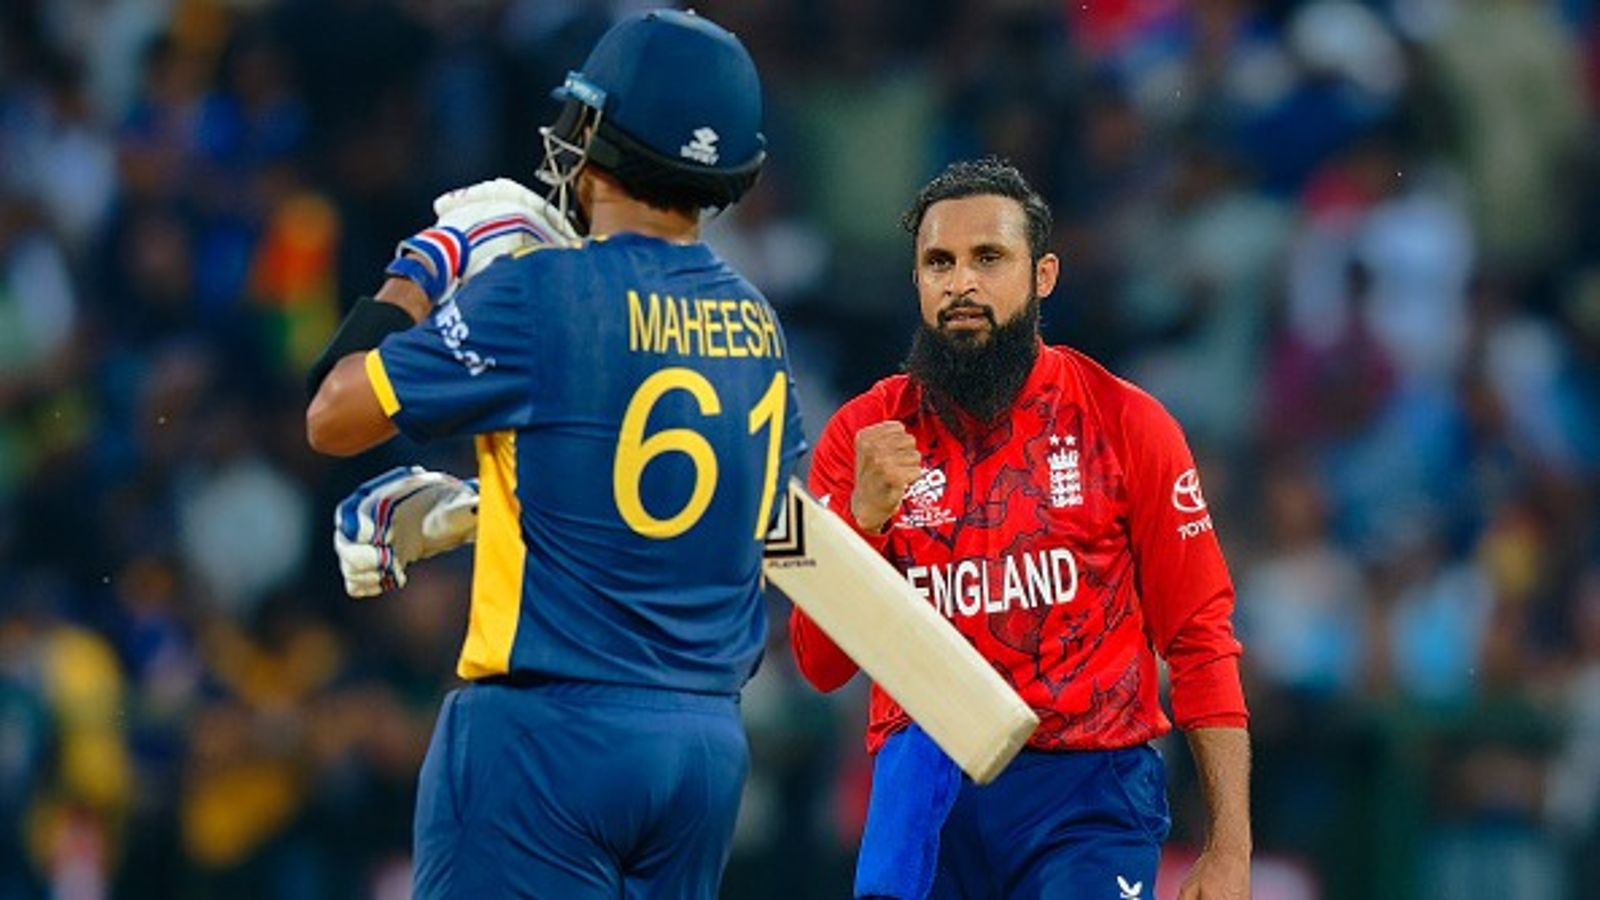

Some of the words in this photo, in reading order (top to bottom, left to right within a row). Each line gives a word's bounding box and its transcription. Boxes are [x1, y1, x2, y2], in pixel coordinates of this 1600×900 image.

[627, 290, 782, 358] MAHEESH
[613, 366, 788, 540] 61
[907, 548, 1078, 617] ENGLAND
